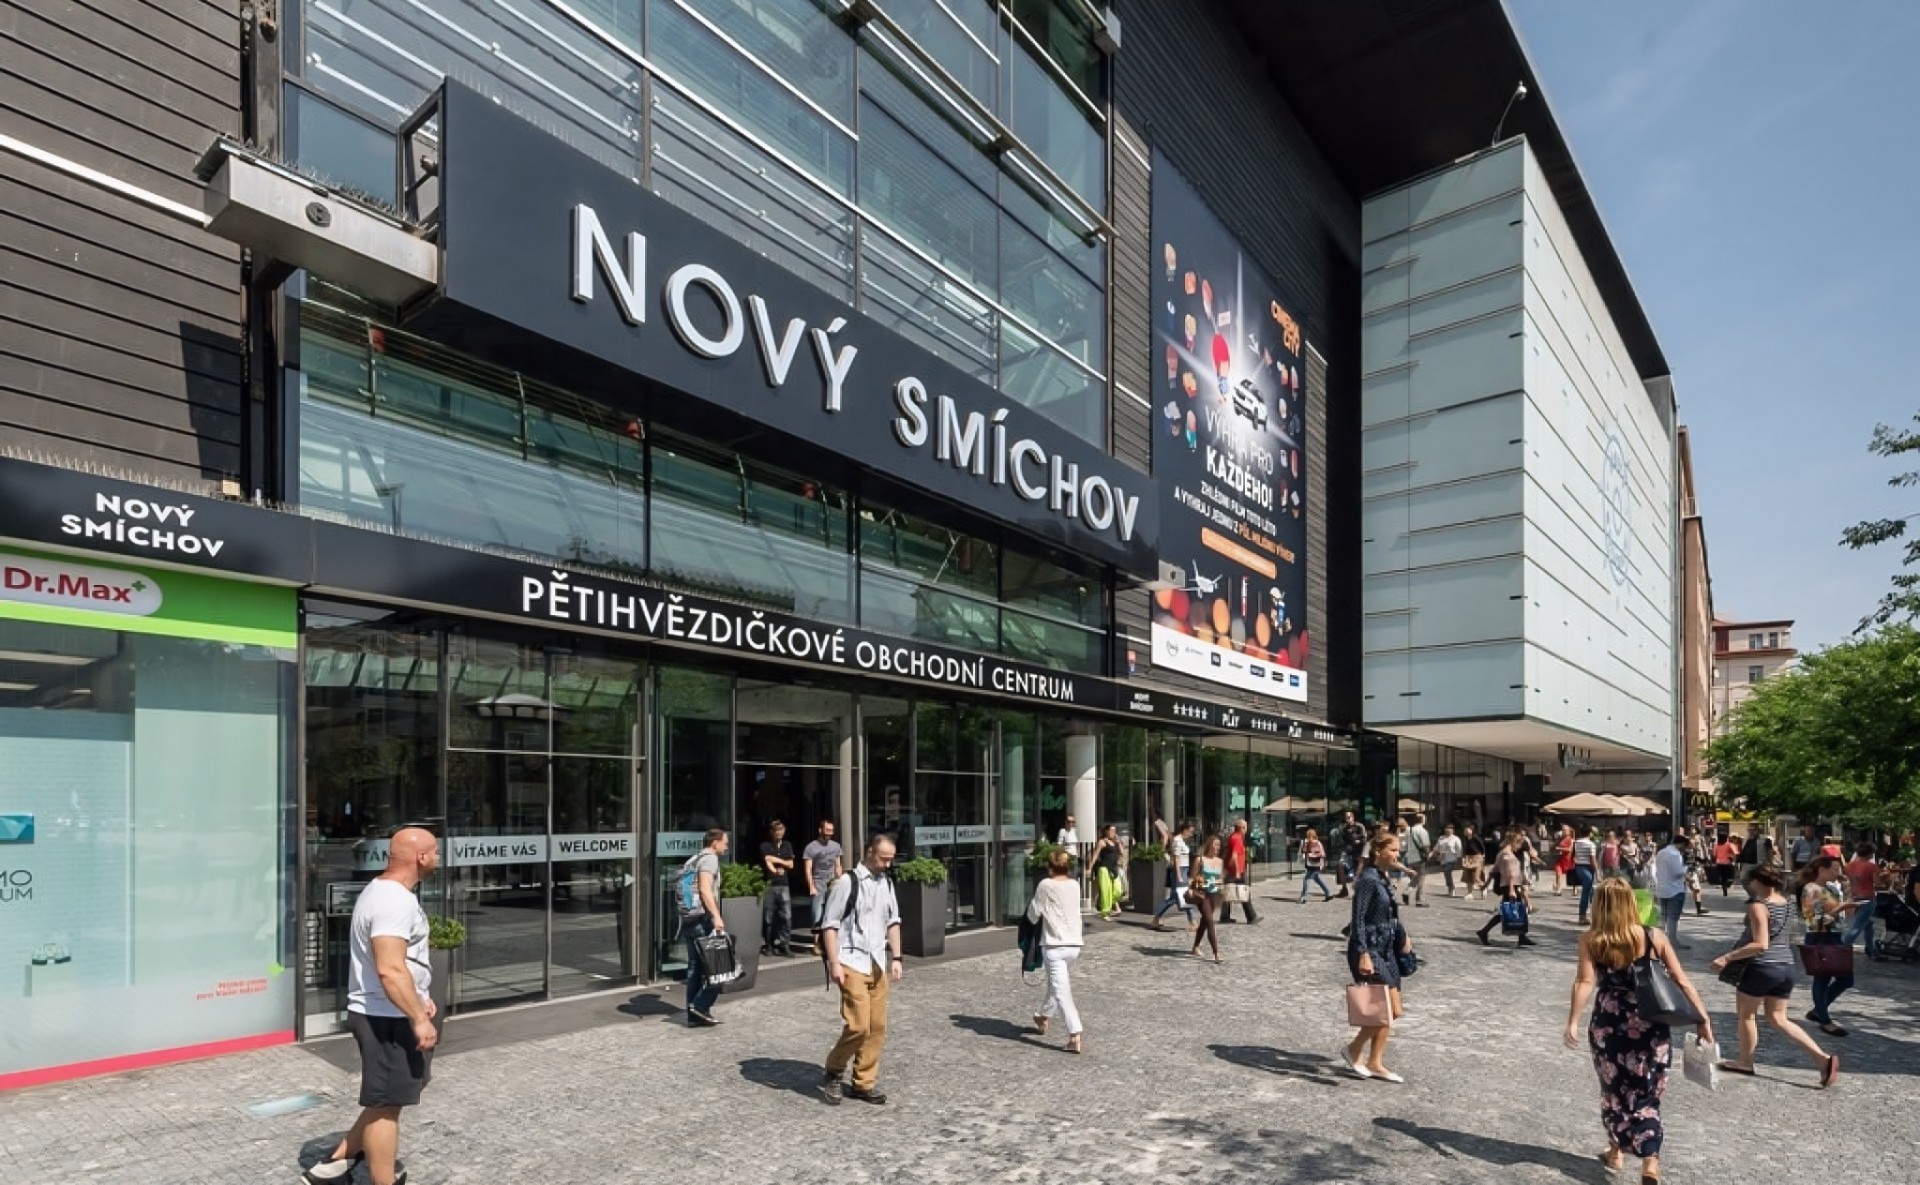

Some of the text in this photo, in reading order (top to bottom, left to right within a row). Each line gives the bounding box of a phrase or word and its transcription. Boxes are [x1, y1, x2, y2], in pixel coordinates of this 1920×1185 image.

[572, 203, 1139, 542] NOVÝ SMÍCHOV
[96, 492, 195, 527] NOVÝ
[61, 514, 224, 558] SMÍCHOV
[4, 566, 131, 603] Dr.Max
[522, 569, 1074, 702] PĚTIHVĚZDIČKOVÉ OBCHODNÍ CENTRUM
[454, 842, 537, 859] VÍTÁME VÁS
[558, 839, 629, 853] WELCOME
